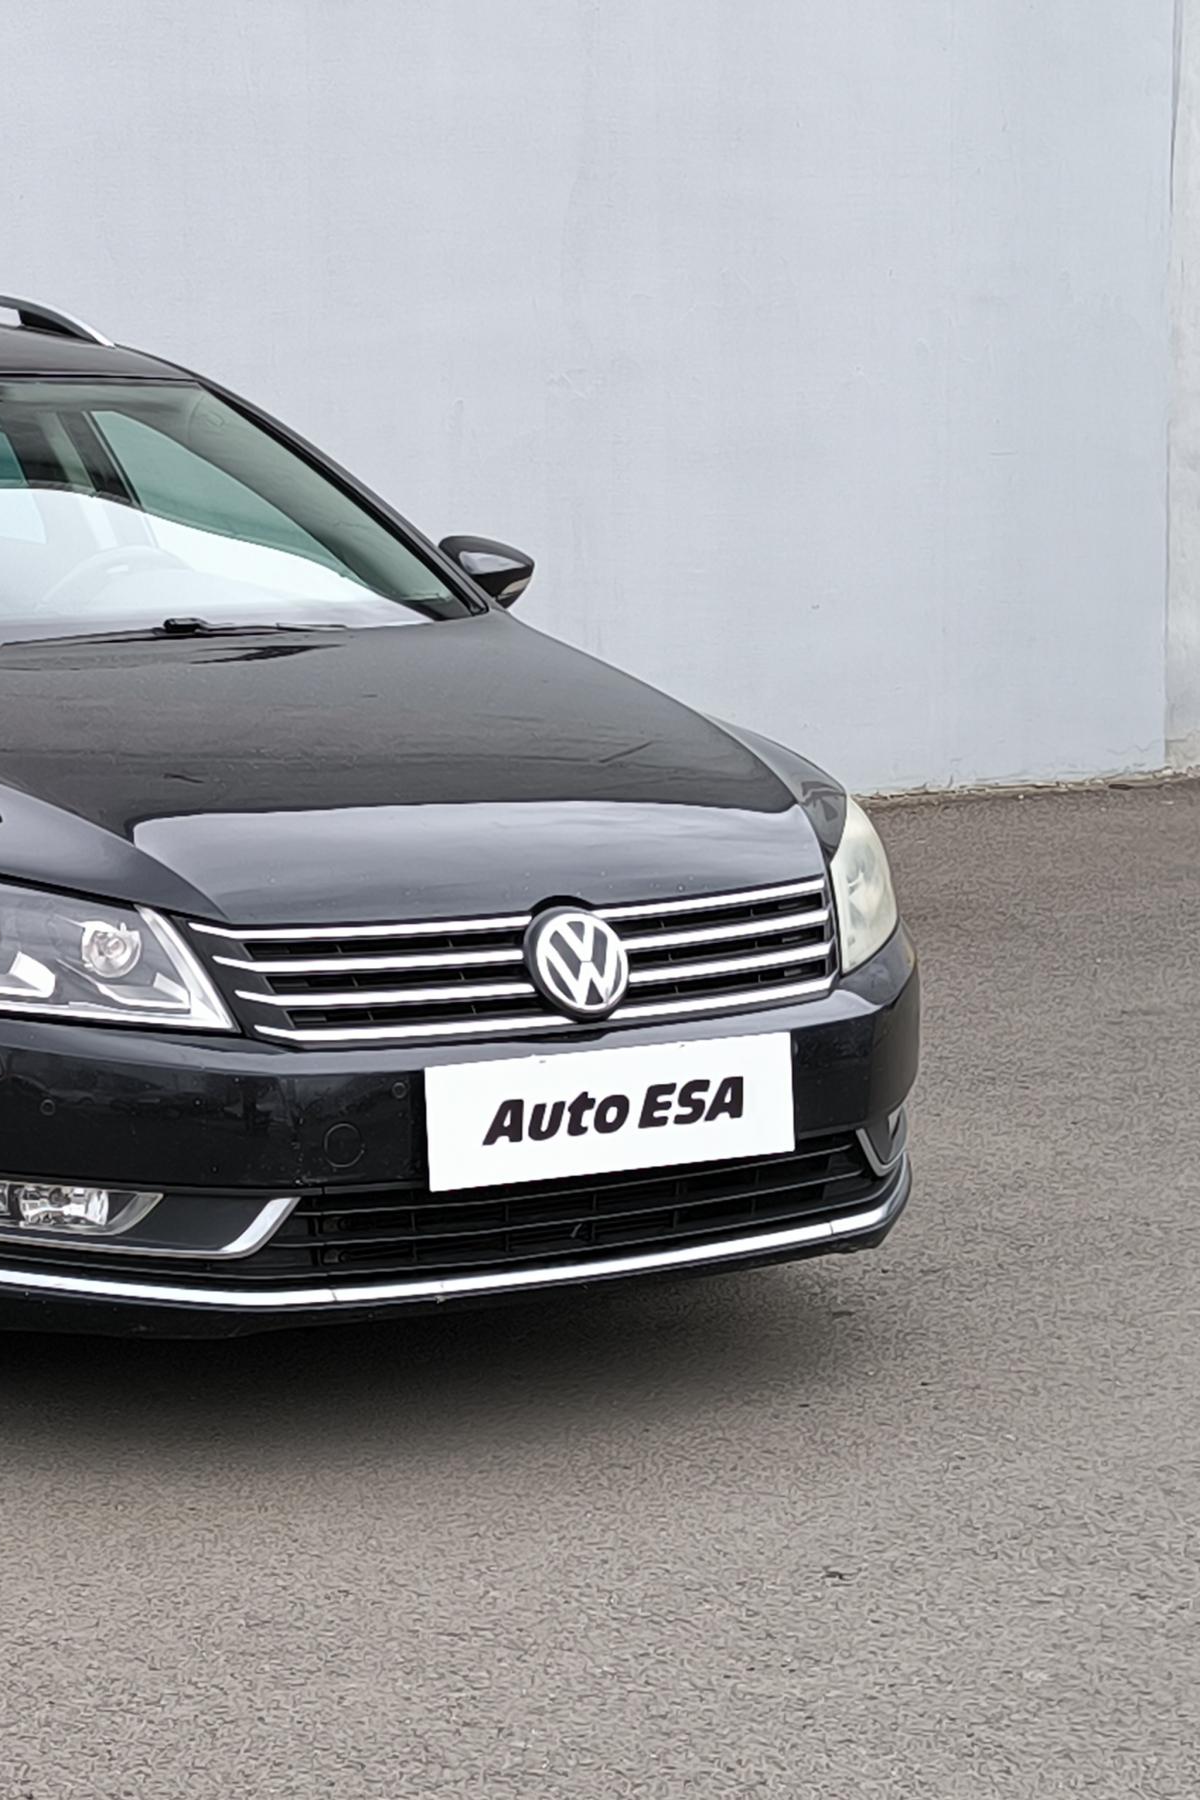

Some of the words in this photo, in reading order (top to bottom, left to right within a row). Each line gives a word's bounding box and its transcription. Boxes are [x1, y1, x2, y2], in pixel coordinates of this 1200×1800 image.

[536, 912, 628, 1011] VW
[482, 1091, 630, 1146] Auto
[637, 1075, 744, 1129] ESA
